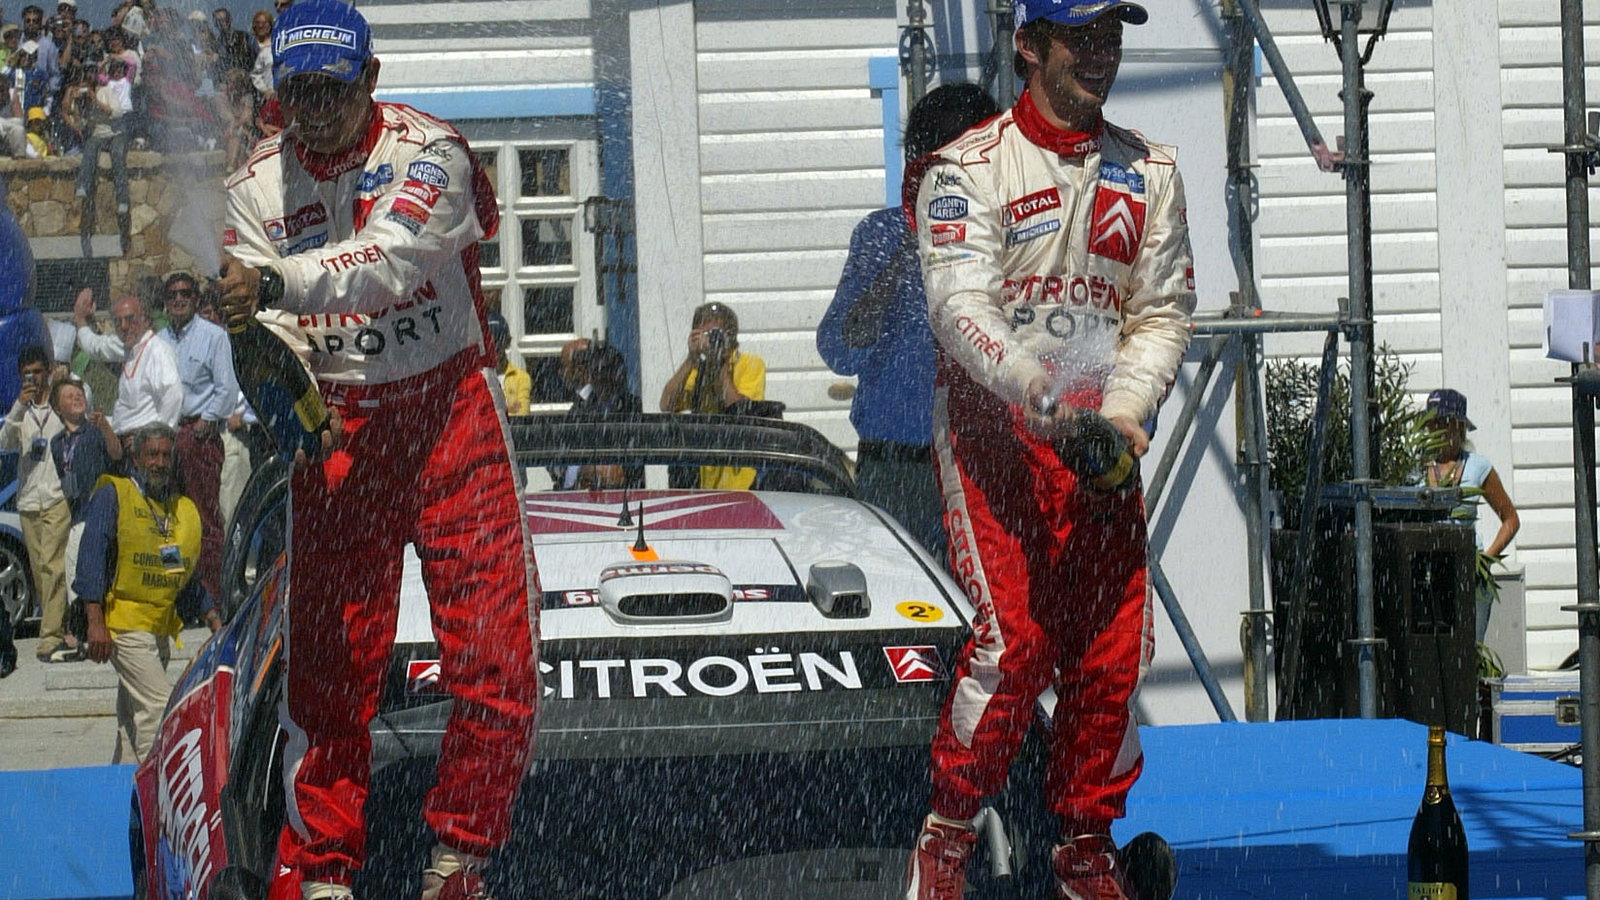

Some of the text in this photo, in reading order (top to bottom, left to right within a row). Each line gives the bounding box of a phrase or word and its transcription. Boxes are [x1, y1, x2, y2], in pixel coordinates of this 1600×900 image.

[288, 28, 352, 44] MICHELIN
[1012, 195, 1058, 216] TOTAL
[320, 244, 391, 273] TROEN
[541, 647, 862, 699] ITROËN
